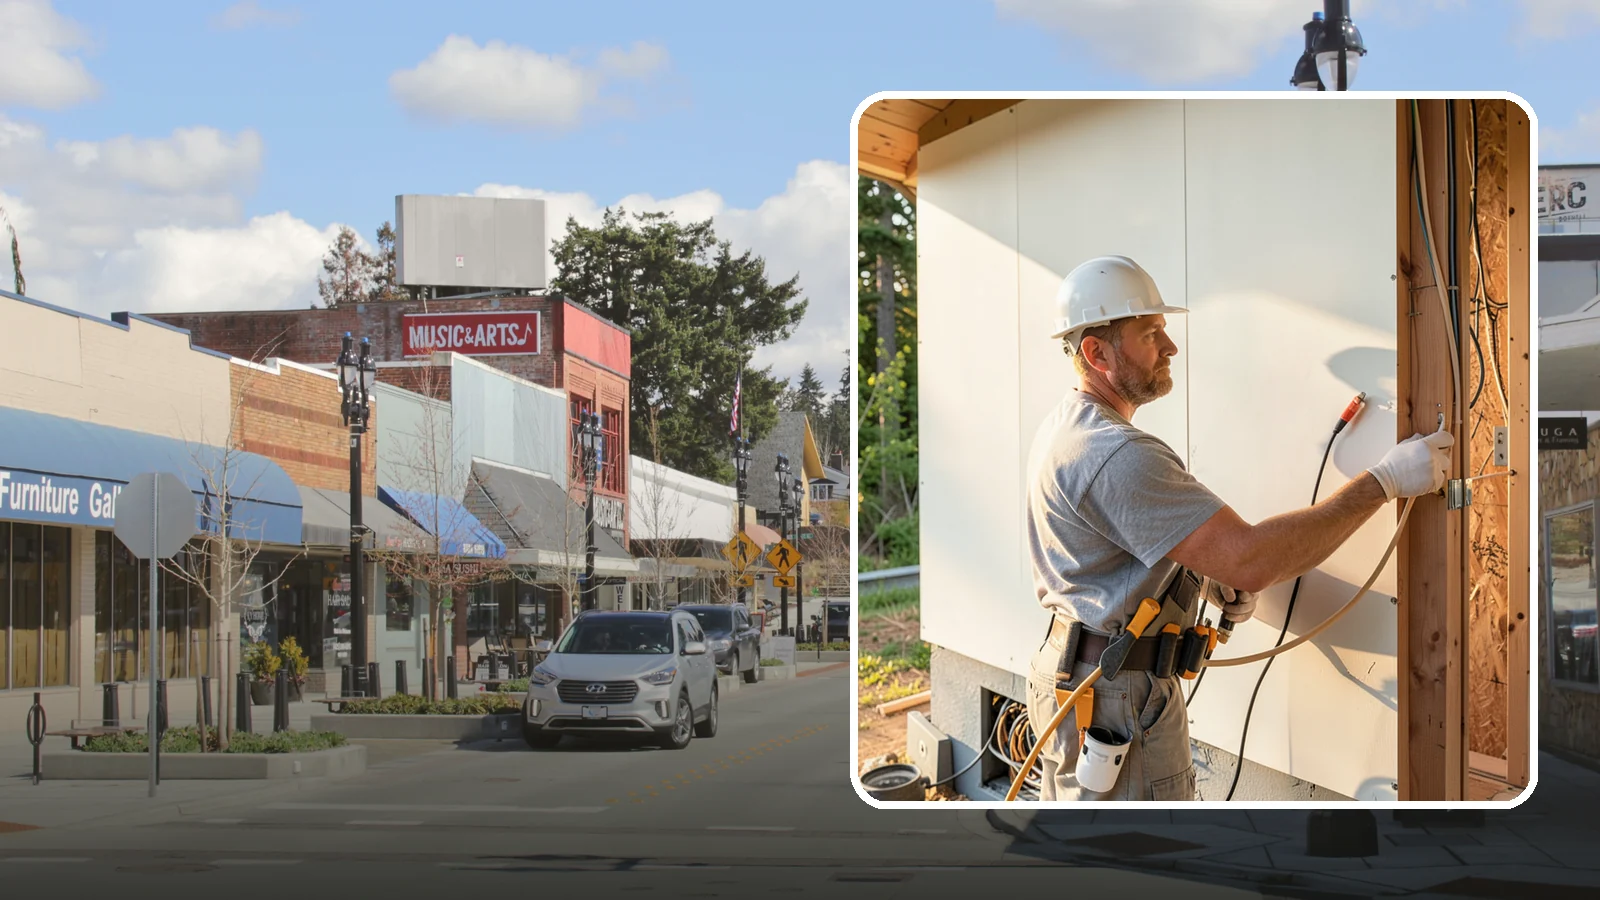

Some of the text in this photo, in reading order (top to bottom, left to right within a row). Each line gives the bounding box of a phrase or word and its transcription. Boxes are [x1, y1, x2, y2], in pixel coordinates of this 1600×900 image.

[409, 323, 520, 348] MUSIC&ARTS
[1541, 428, 1577, 436] UGA
[0, 471, 121, 519] Furniture Gal
[328, 594, 341, 606] HAIR
